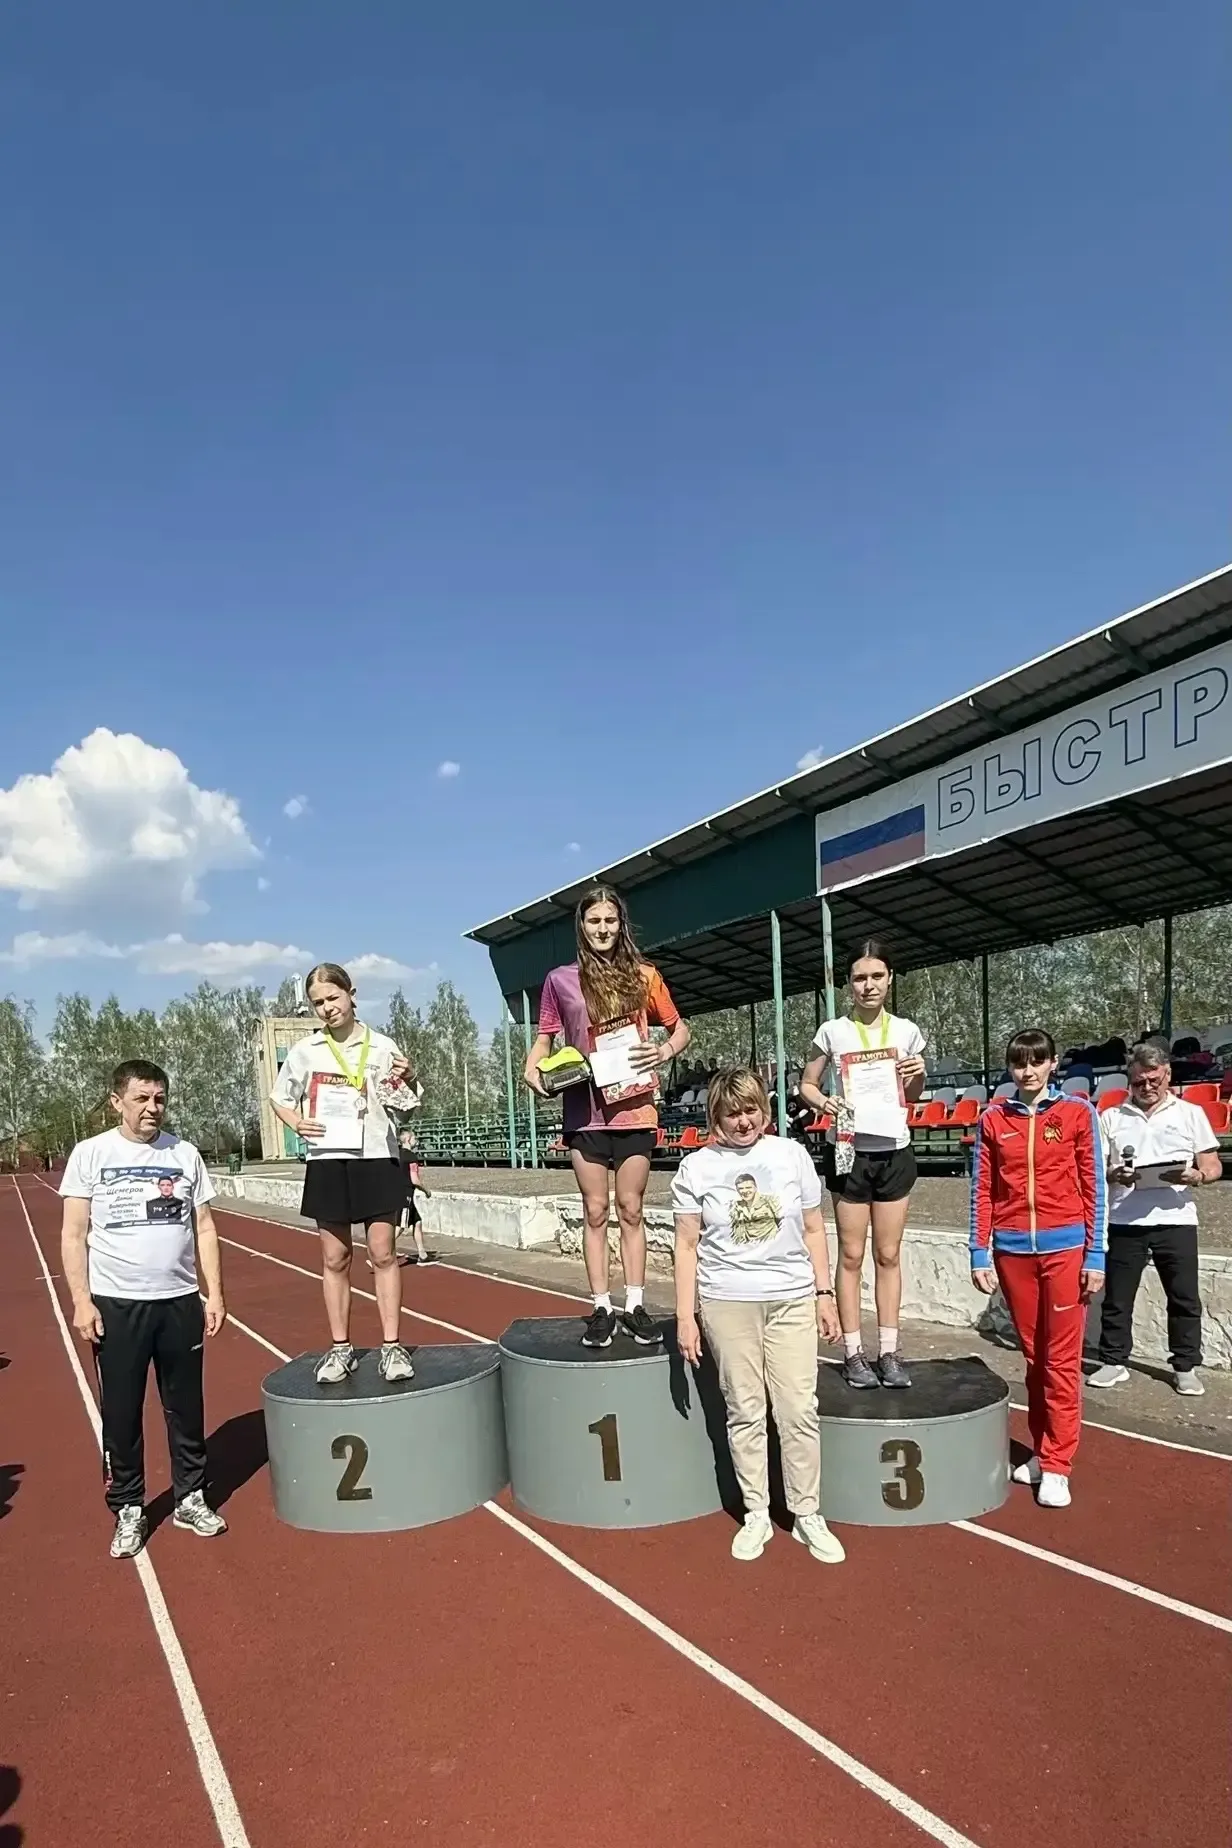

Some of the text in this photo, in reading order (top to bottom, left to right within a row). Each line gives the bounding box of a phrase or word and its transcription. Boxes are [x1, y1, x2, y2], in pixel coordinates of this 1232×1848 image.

[938, 667, 1229, 831] БЫСТР
[599, 1017, 632, 1034] ГРАМОТА
[851, 1051, 889, 1062] ГРАМОТА
[330, 1434, 373, 1501] 2
[588, 1413, 622, 1482] 1
[880, 1438, 925, 1511] 3
